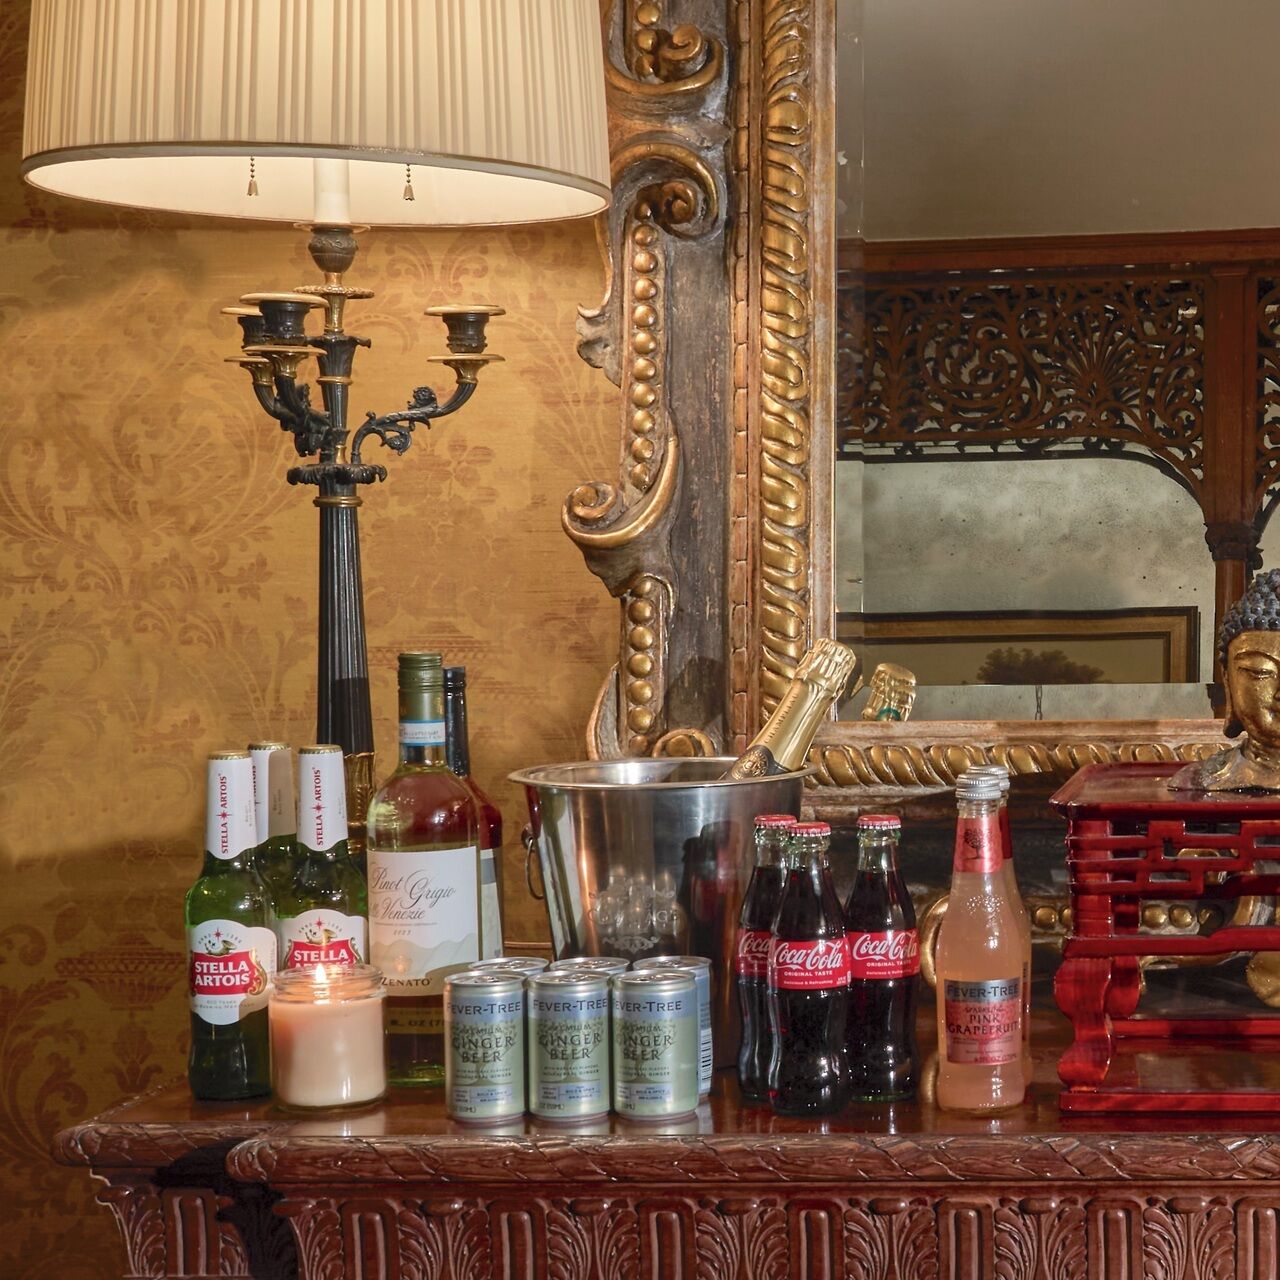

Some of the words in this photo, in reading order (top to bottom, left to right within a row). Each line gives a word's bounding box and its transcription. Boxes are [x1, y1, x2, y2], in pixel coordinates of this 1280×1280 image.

[219, 775, 228, 809] ARTOIS
[313, 769, 322, 802] ARTOIS
[315, 814, 324, 846] STELLA
[220, 822, 229, 854] STELLA
[369, 865, 404, 894] Pinot
[400, 869, 456, 909] Grigio
[380, 896, 426, 920] Venezie
[294, 948, 349, 961] STELLA
[773, 941, 843, 971] Coca-Cola
[194, 960, 249, 974] STELLA
[194, 973, 250, 987] ARTOIS
[381, 976, 431, 987] ZENATO
[946, 983, 1018, 998] FEVER-TREE
[447, 1001, 521, 1015] FEVER-TREE
[533, 999, 608, 1012] FEVER-TREE
[613, 1000, 682, 1013] EVER-TREE
[969, 1014, 1001, 1024] PINK
[947, 1021, 1018, 1035] GRAPEFRUIT
[453, 1035, 514, 1049] GINGER
[538, 1032, 602, 1047] GINGER
[462, 1050, 502, 1063] BEER
[550, 1048, 591, 1061] BEER
[623, 1048, 661, 1061] BEER
